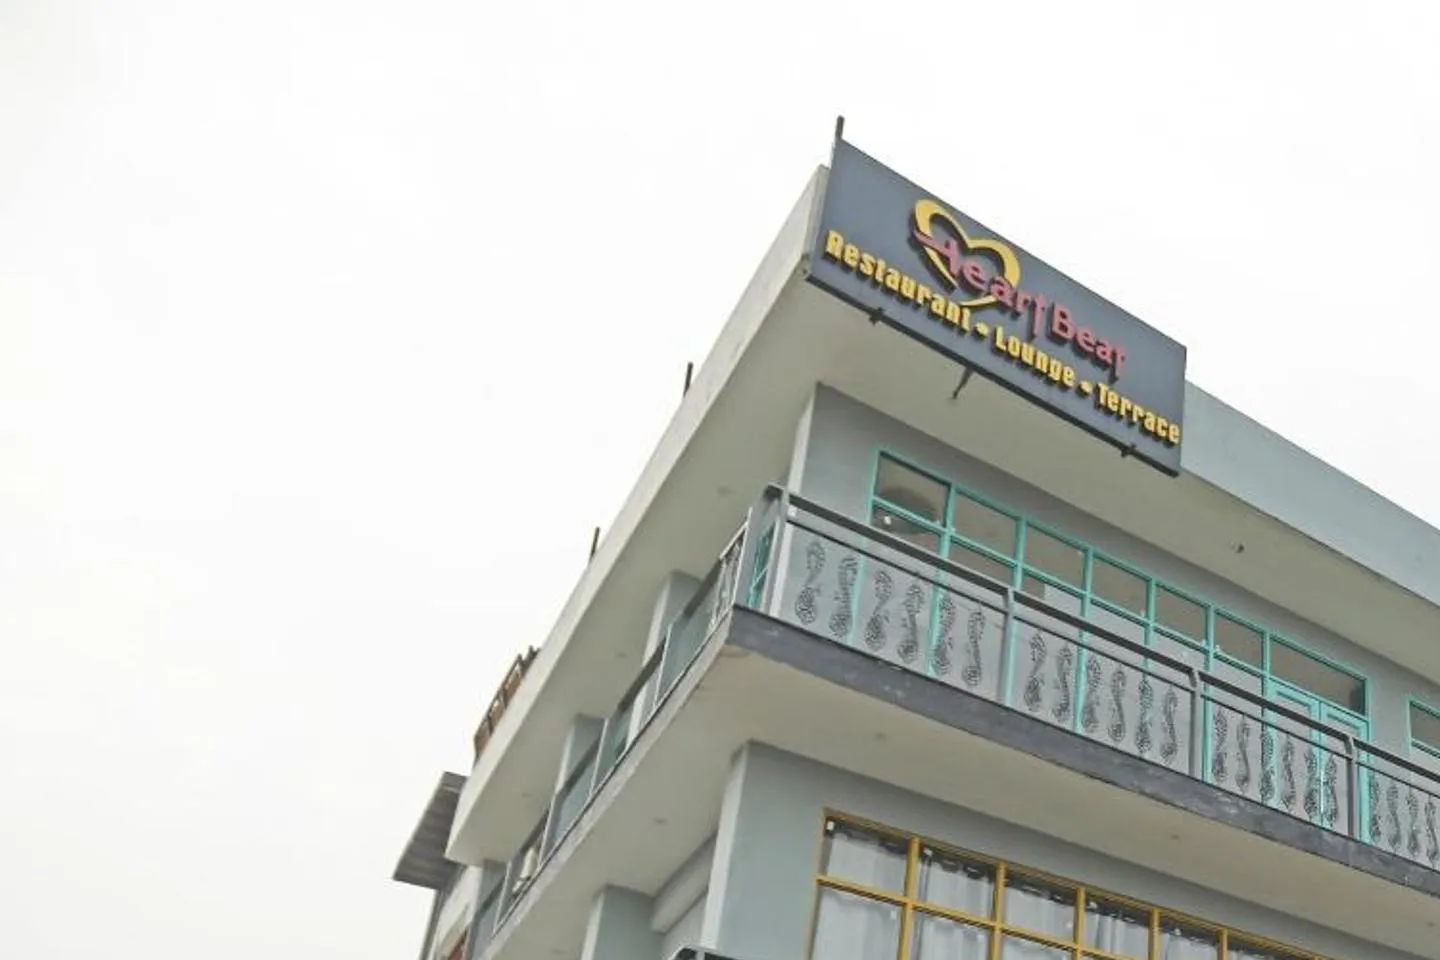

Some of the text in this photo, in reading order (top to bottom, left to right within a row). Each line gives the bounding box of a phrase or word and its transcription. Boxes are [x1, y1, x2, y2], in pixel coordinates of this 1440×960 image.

[825, 229, 1181, 445] Restaurant Lounge Terrace
[1052, 303, 1127, 377] Beat
